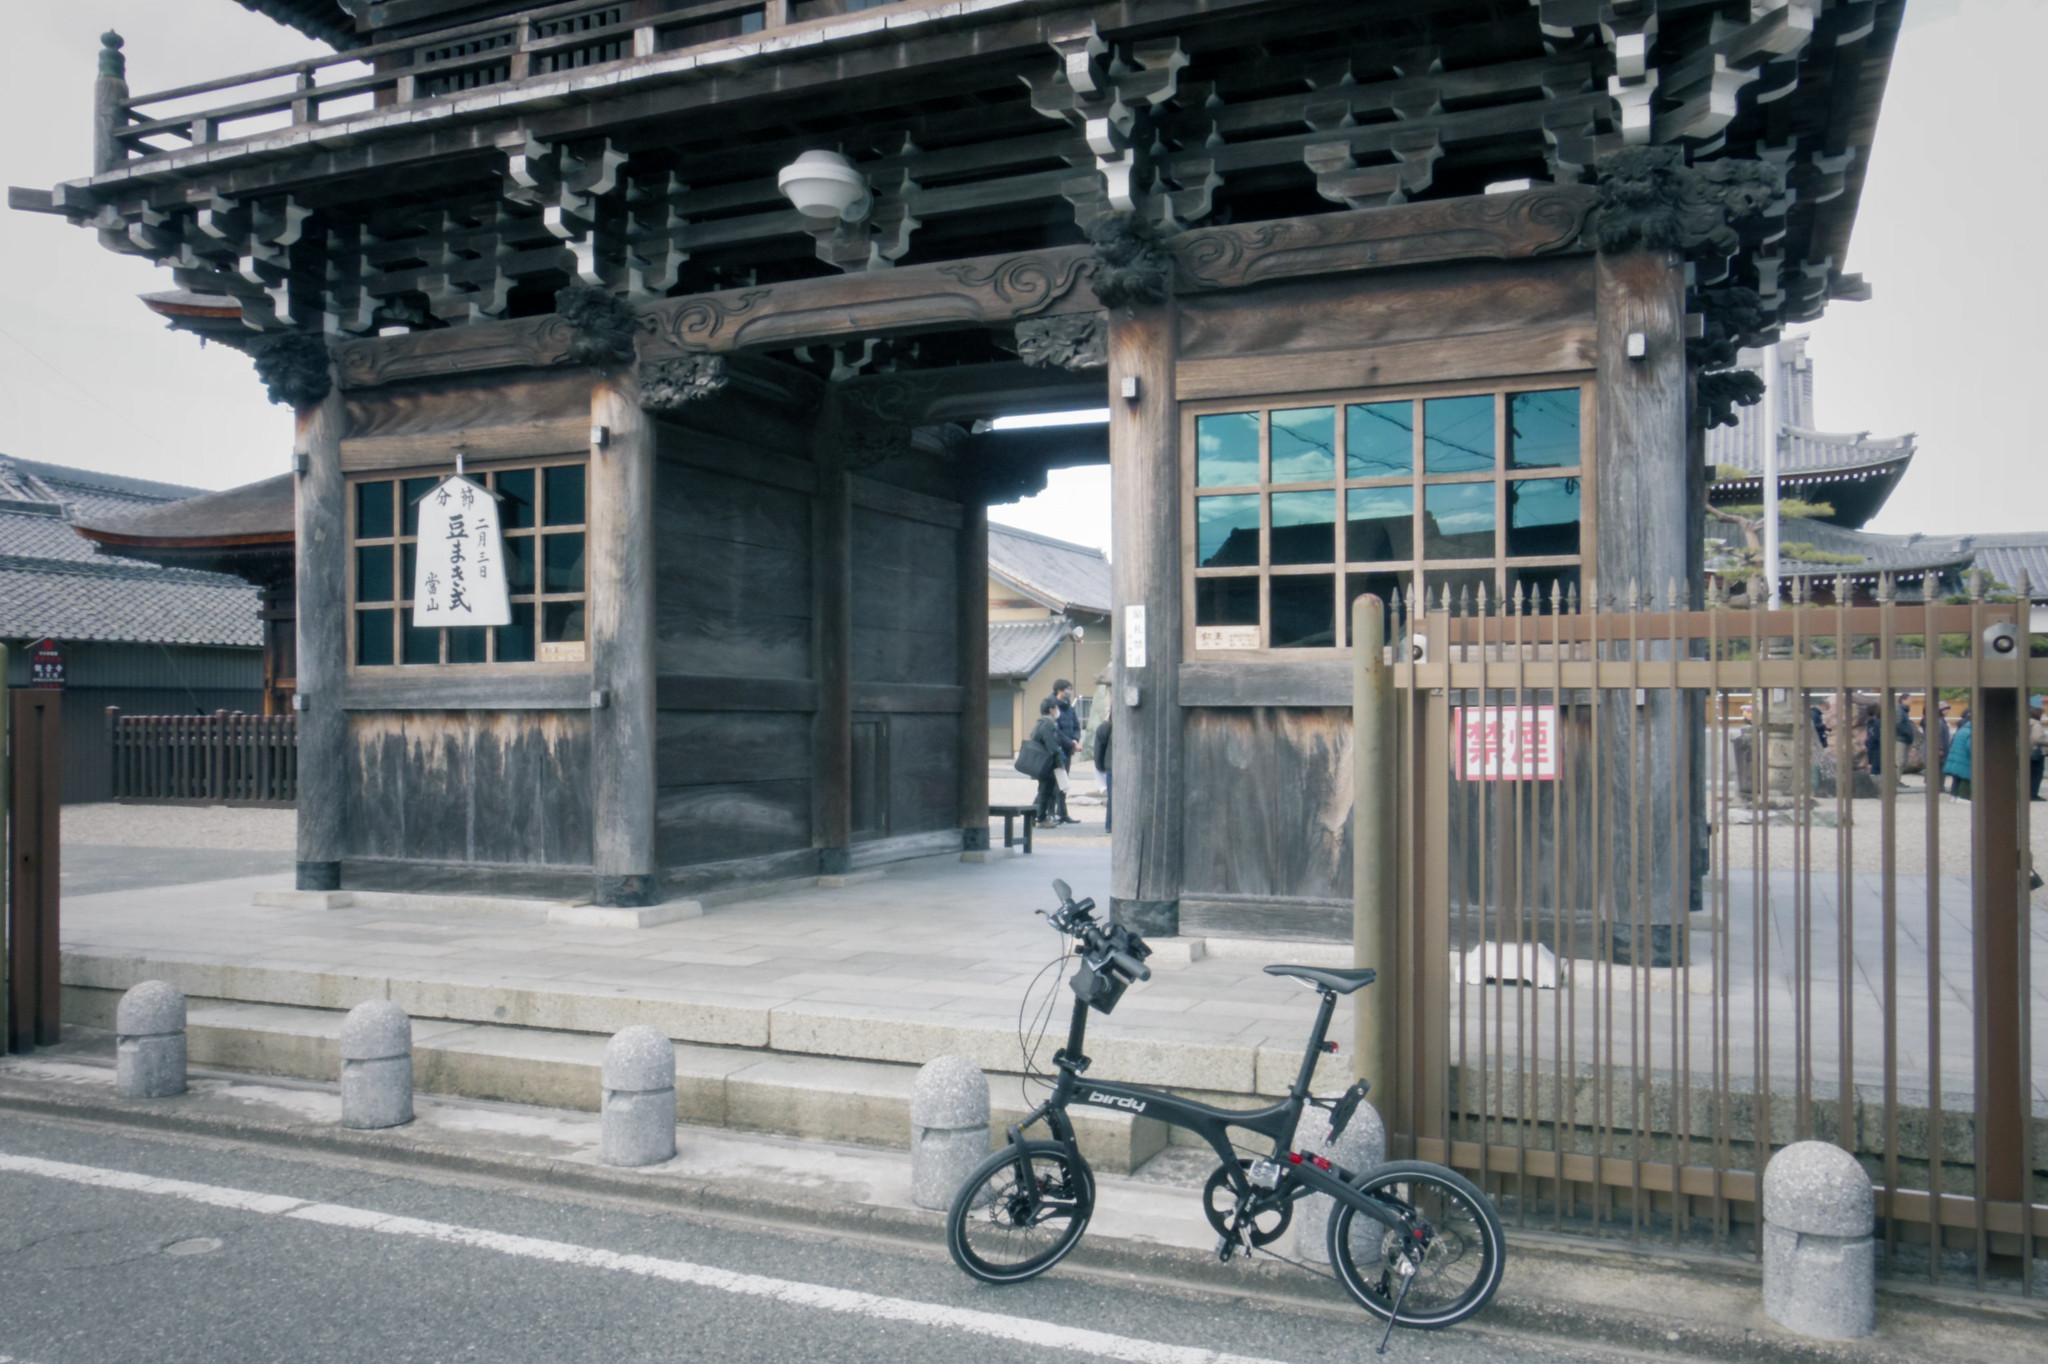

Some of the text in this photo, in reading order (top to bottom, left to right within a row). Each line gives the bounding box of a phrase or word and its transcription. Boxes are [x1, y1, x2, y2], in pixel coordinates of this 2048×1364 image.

[446, 513, 472, 613] 豆まき式
[475, 518, 490, 578] 二月三日
[1089, 1091, 1147, 1112] birdy
